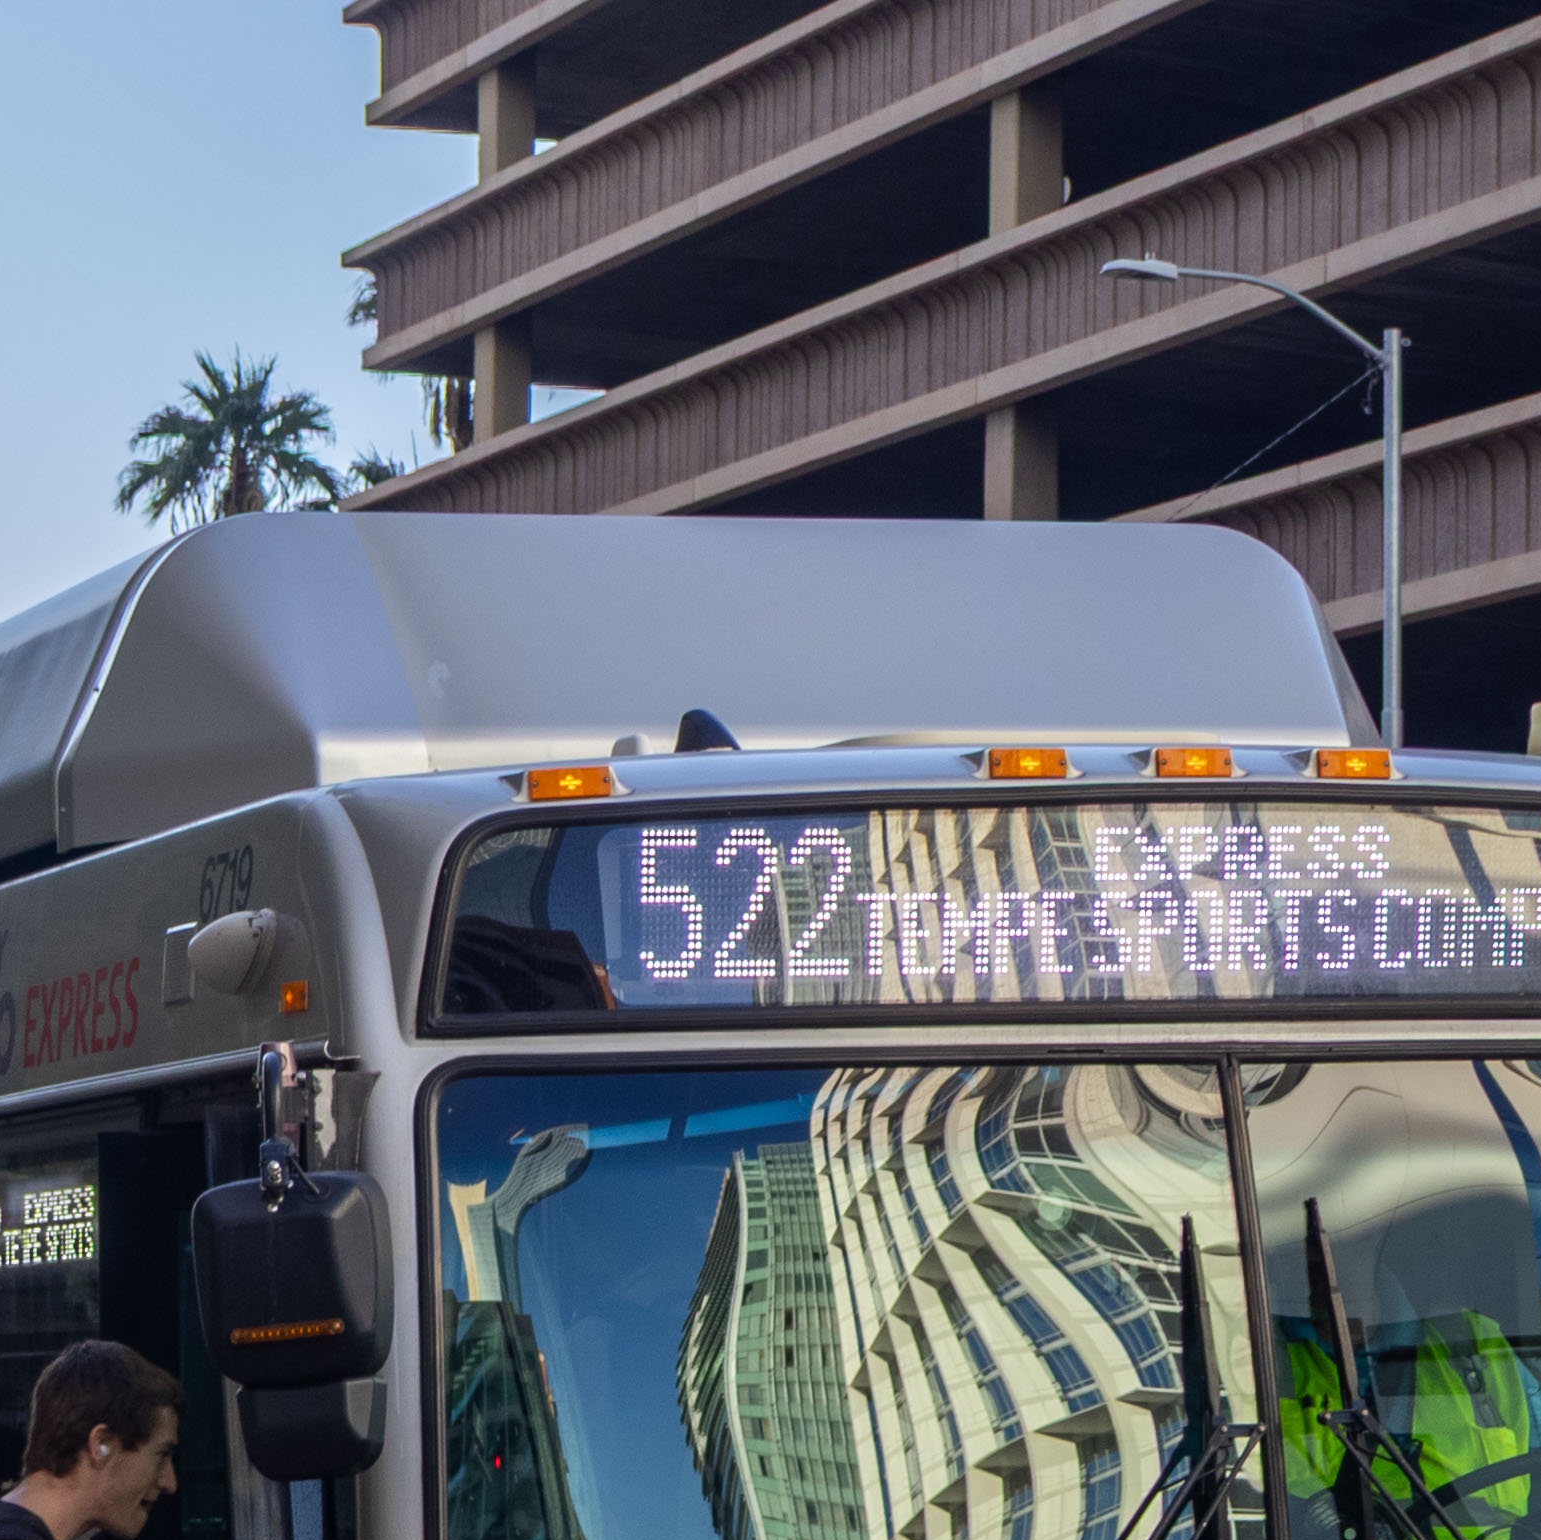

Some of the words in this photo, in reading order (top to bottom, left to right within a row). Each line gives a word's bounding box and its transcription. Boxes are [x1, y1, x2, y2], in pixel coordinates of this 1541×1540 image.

[199, 844, 254, 920] 6719
[1091, 825, 1391, 881] EXPRESS
[639, 828, 852, 979] 522
[856, 891, 1075, 976] TEMPE
[1091, 888, 1360, 972] SPORTS
[23, 957, 140, 1068] EXPRESS
[23, 1184, 94, 1225] EXPRESS
